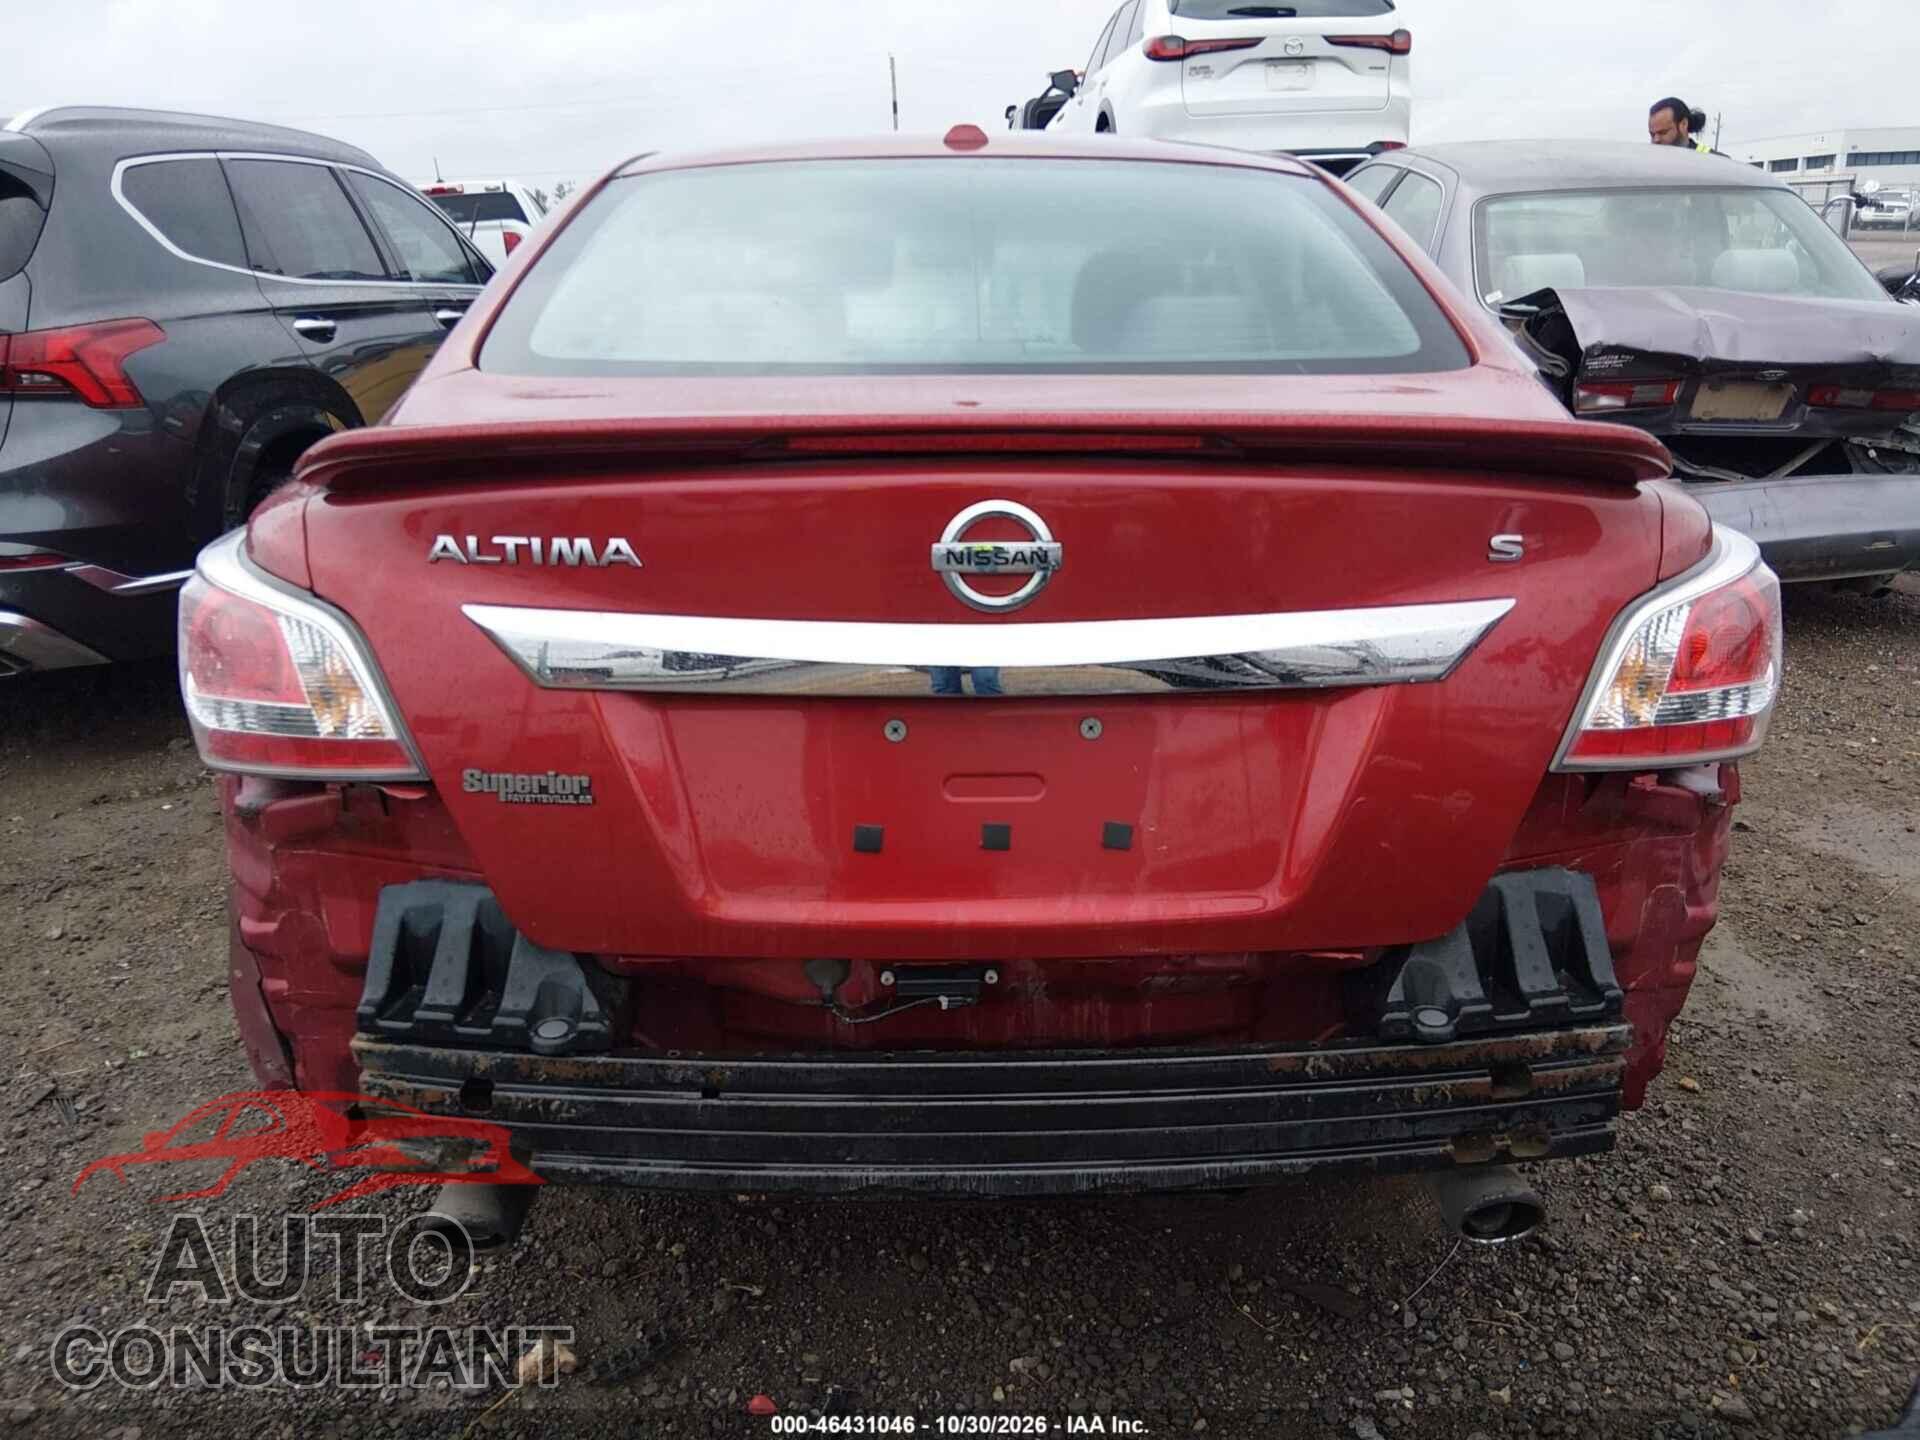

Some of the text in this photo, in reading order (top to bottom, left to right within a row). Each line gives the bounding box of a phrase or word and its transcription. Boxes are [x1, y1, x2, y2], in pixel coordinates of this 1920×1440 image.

[428, 535, 643, 568] ALTIMA
[946, 547, 1049, 566] NISSAN
[1488, 534, 1524, 561] S
[463, 768, 591, 801] Superior
